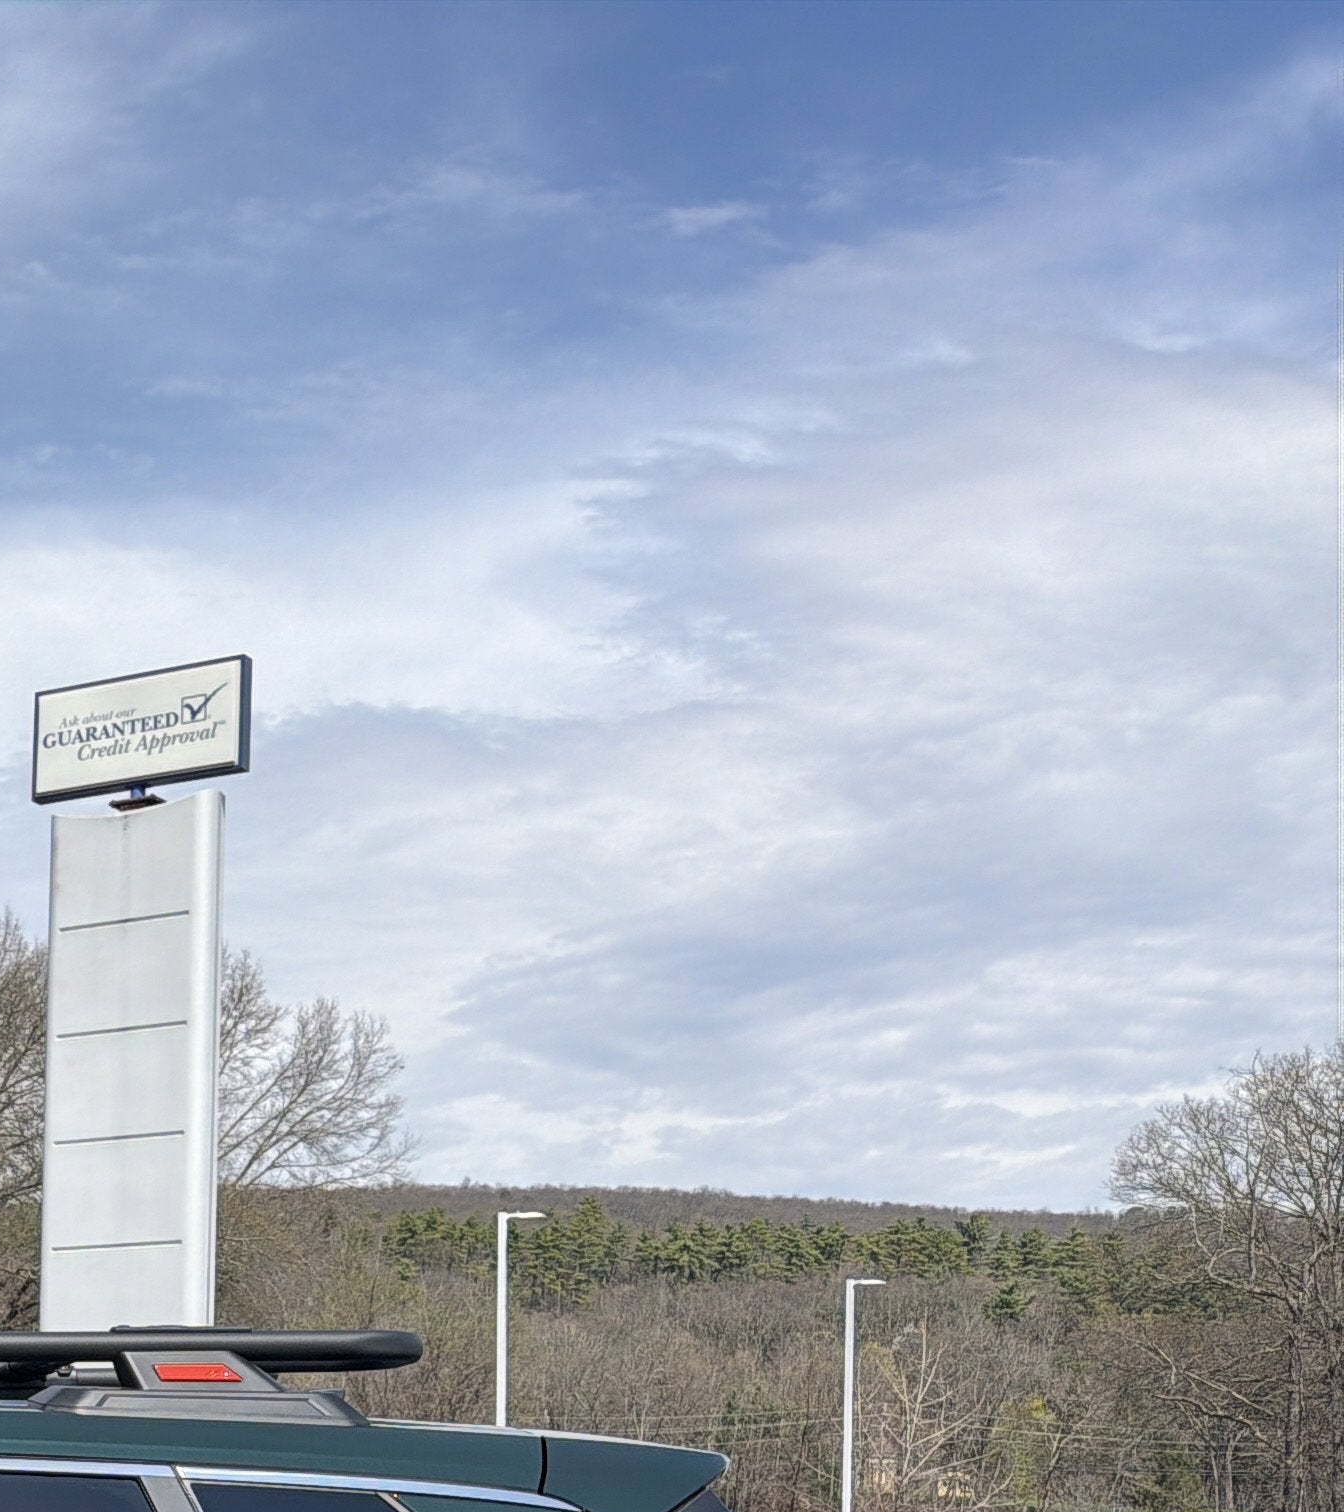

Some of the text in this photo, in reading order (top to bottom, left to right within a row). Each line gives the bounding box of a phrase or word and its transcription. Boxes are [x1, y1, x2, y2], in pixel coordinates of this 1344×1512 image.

[42, 711, 179, 750] GUARANTEED
[58, 708, 137, 730] Ask about our
[77, 721, 218, 761] Credit Approval
